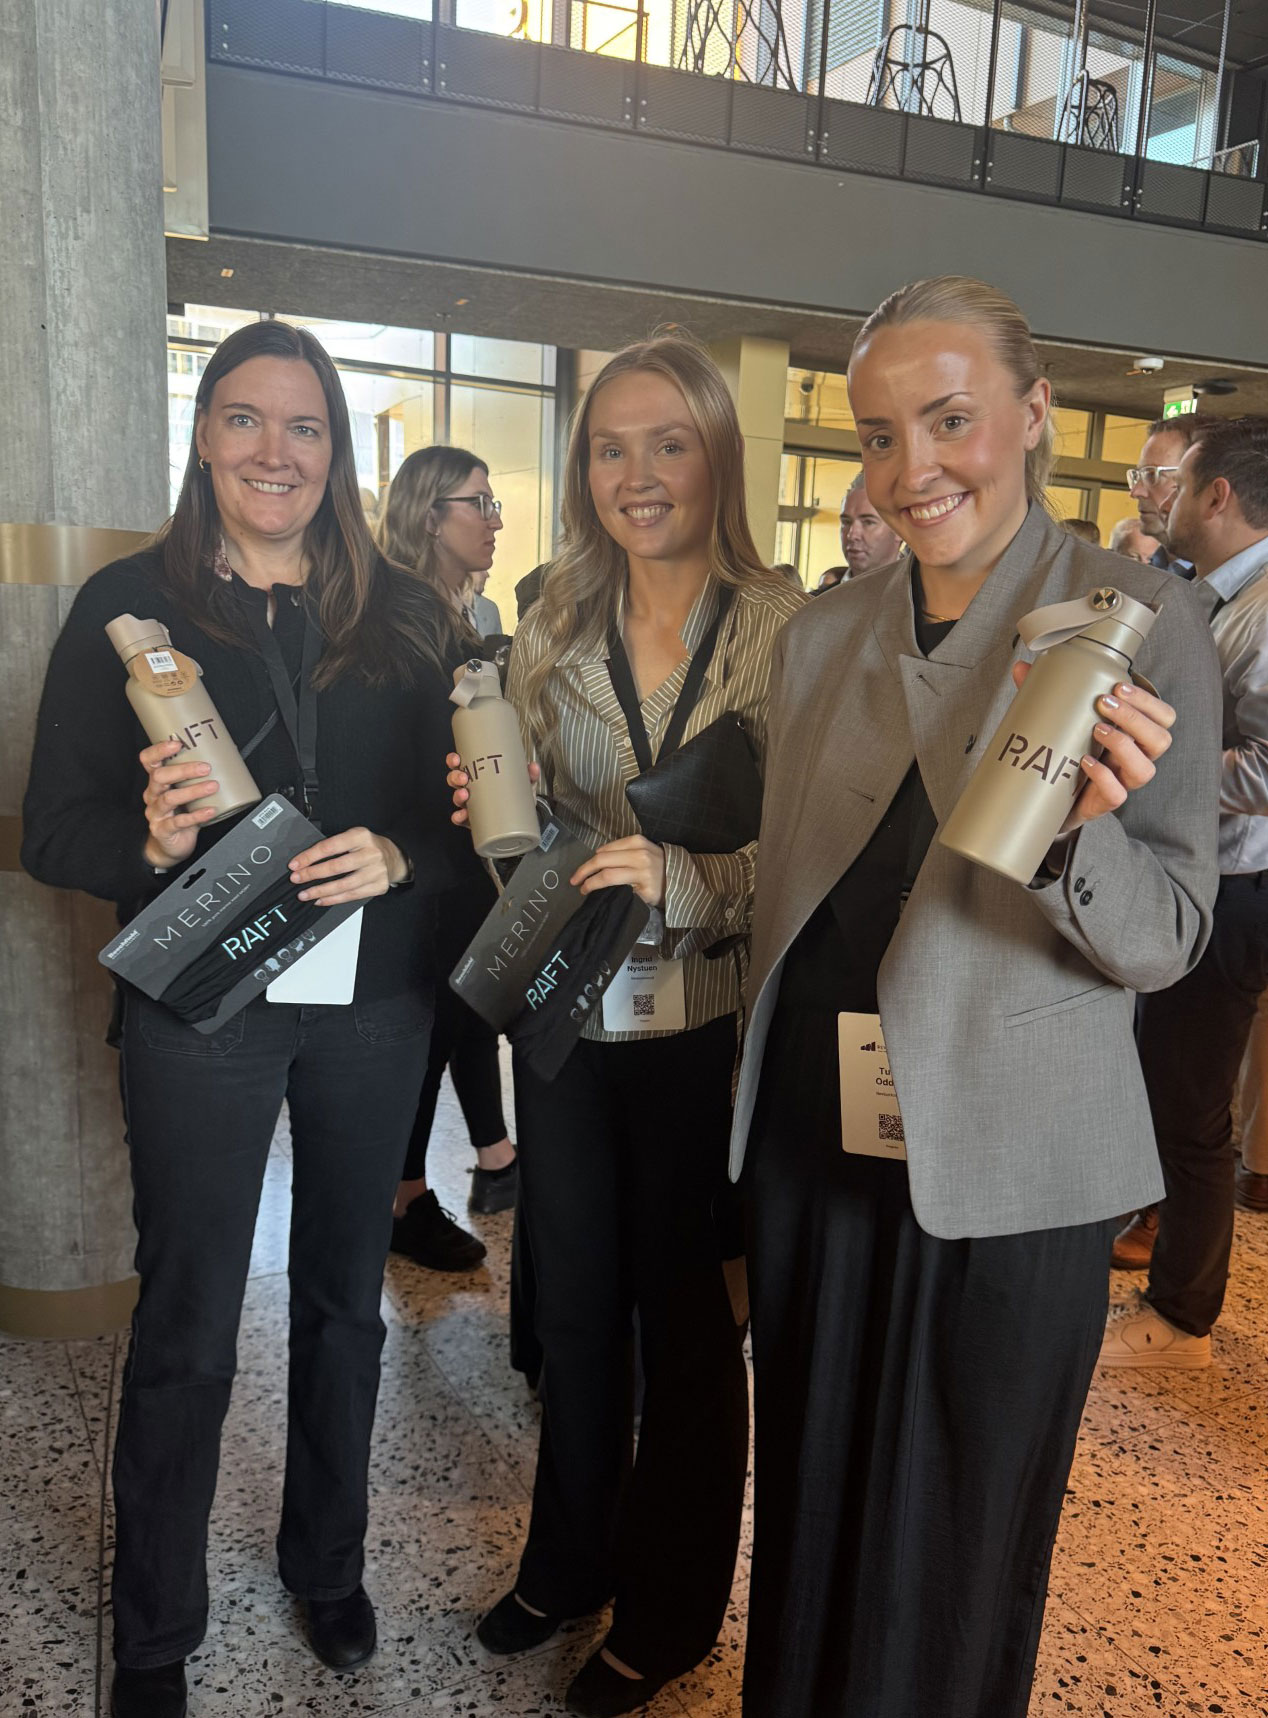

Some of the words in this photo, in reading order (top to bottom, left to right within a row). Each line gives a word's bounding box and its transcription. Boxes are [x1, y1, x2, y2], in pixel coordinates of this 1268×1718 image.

[162, 718, 218, 763] AFT
[463, 753, 503, 782] AFT
[998, 732, 1080, 796] RAF
[153, 845, 272, 950] MERINO
[221, 904, 288, 960] RAFT
[486, 869, 559, 981] MERINO
[525, 950, 570, 1011] RAFT
[627, 965, 658, 973] Nystuen
[631, 956, 653, 964] Ingrid
[875, 1077, 894, 1087] Odd
[879, 1066, 891, 1075] Tu
